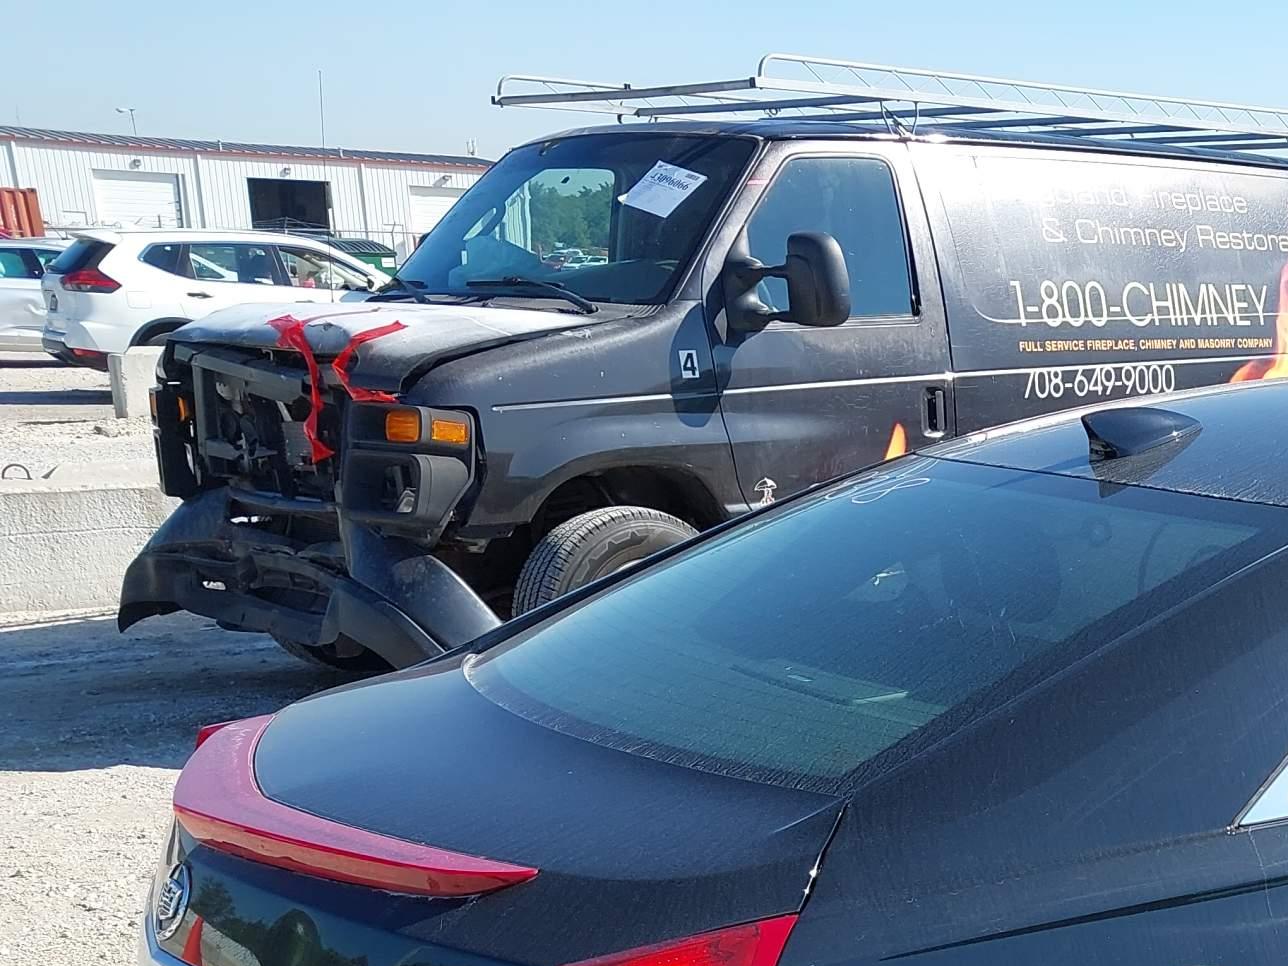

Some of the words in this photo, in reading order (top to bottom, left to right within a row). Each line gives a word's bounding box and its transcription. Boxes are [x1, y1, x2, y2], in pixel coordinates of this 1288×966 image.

[1041, 217, 1067, 243] &
[1075, 217, 1188, 252] Chimney
[1009, 280, 1267, 328] 1-800-CHIMNEY
[1019, 340, 1044, 352] FULL
[1045, 340, 1085, 352] SERVICE
[1087, 338, 1138, 352] FIREPLACE,
[1140, 338, 1177, 350] CHIMNEY
[1179, 338, 1196, 349] AND
[1198, 338, 1235, 349] MASONRY
[1237, 338, 1273, 349] COMPANY
[683, 352, 697, 377] 4
[1024, 363, 1176, 399] 708-649-9000
